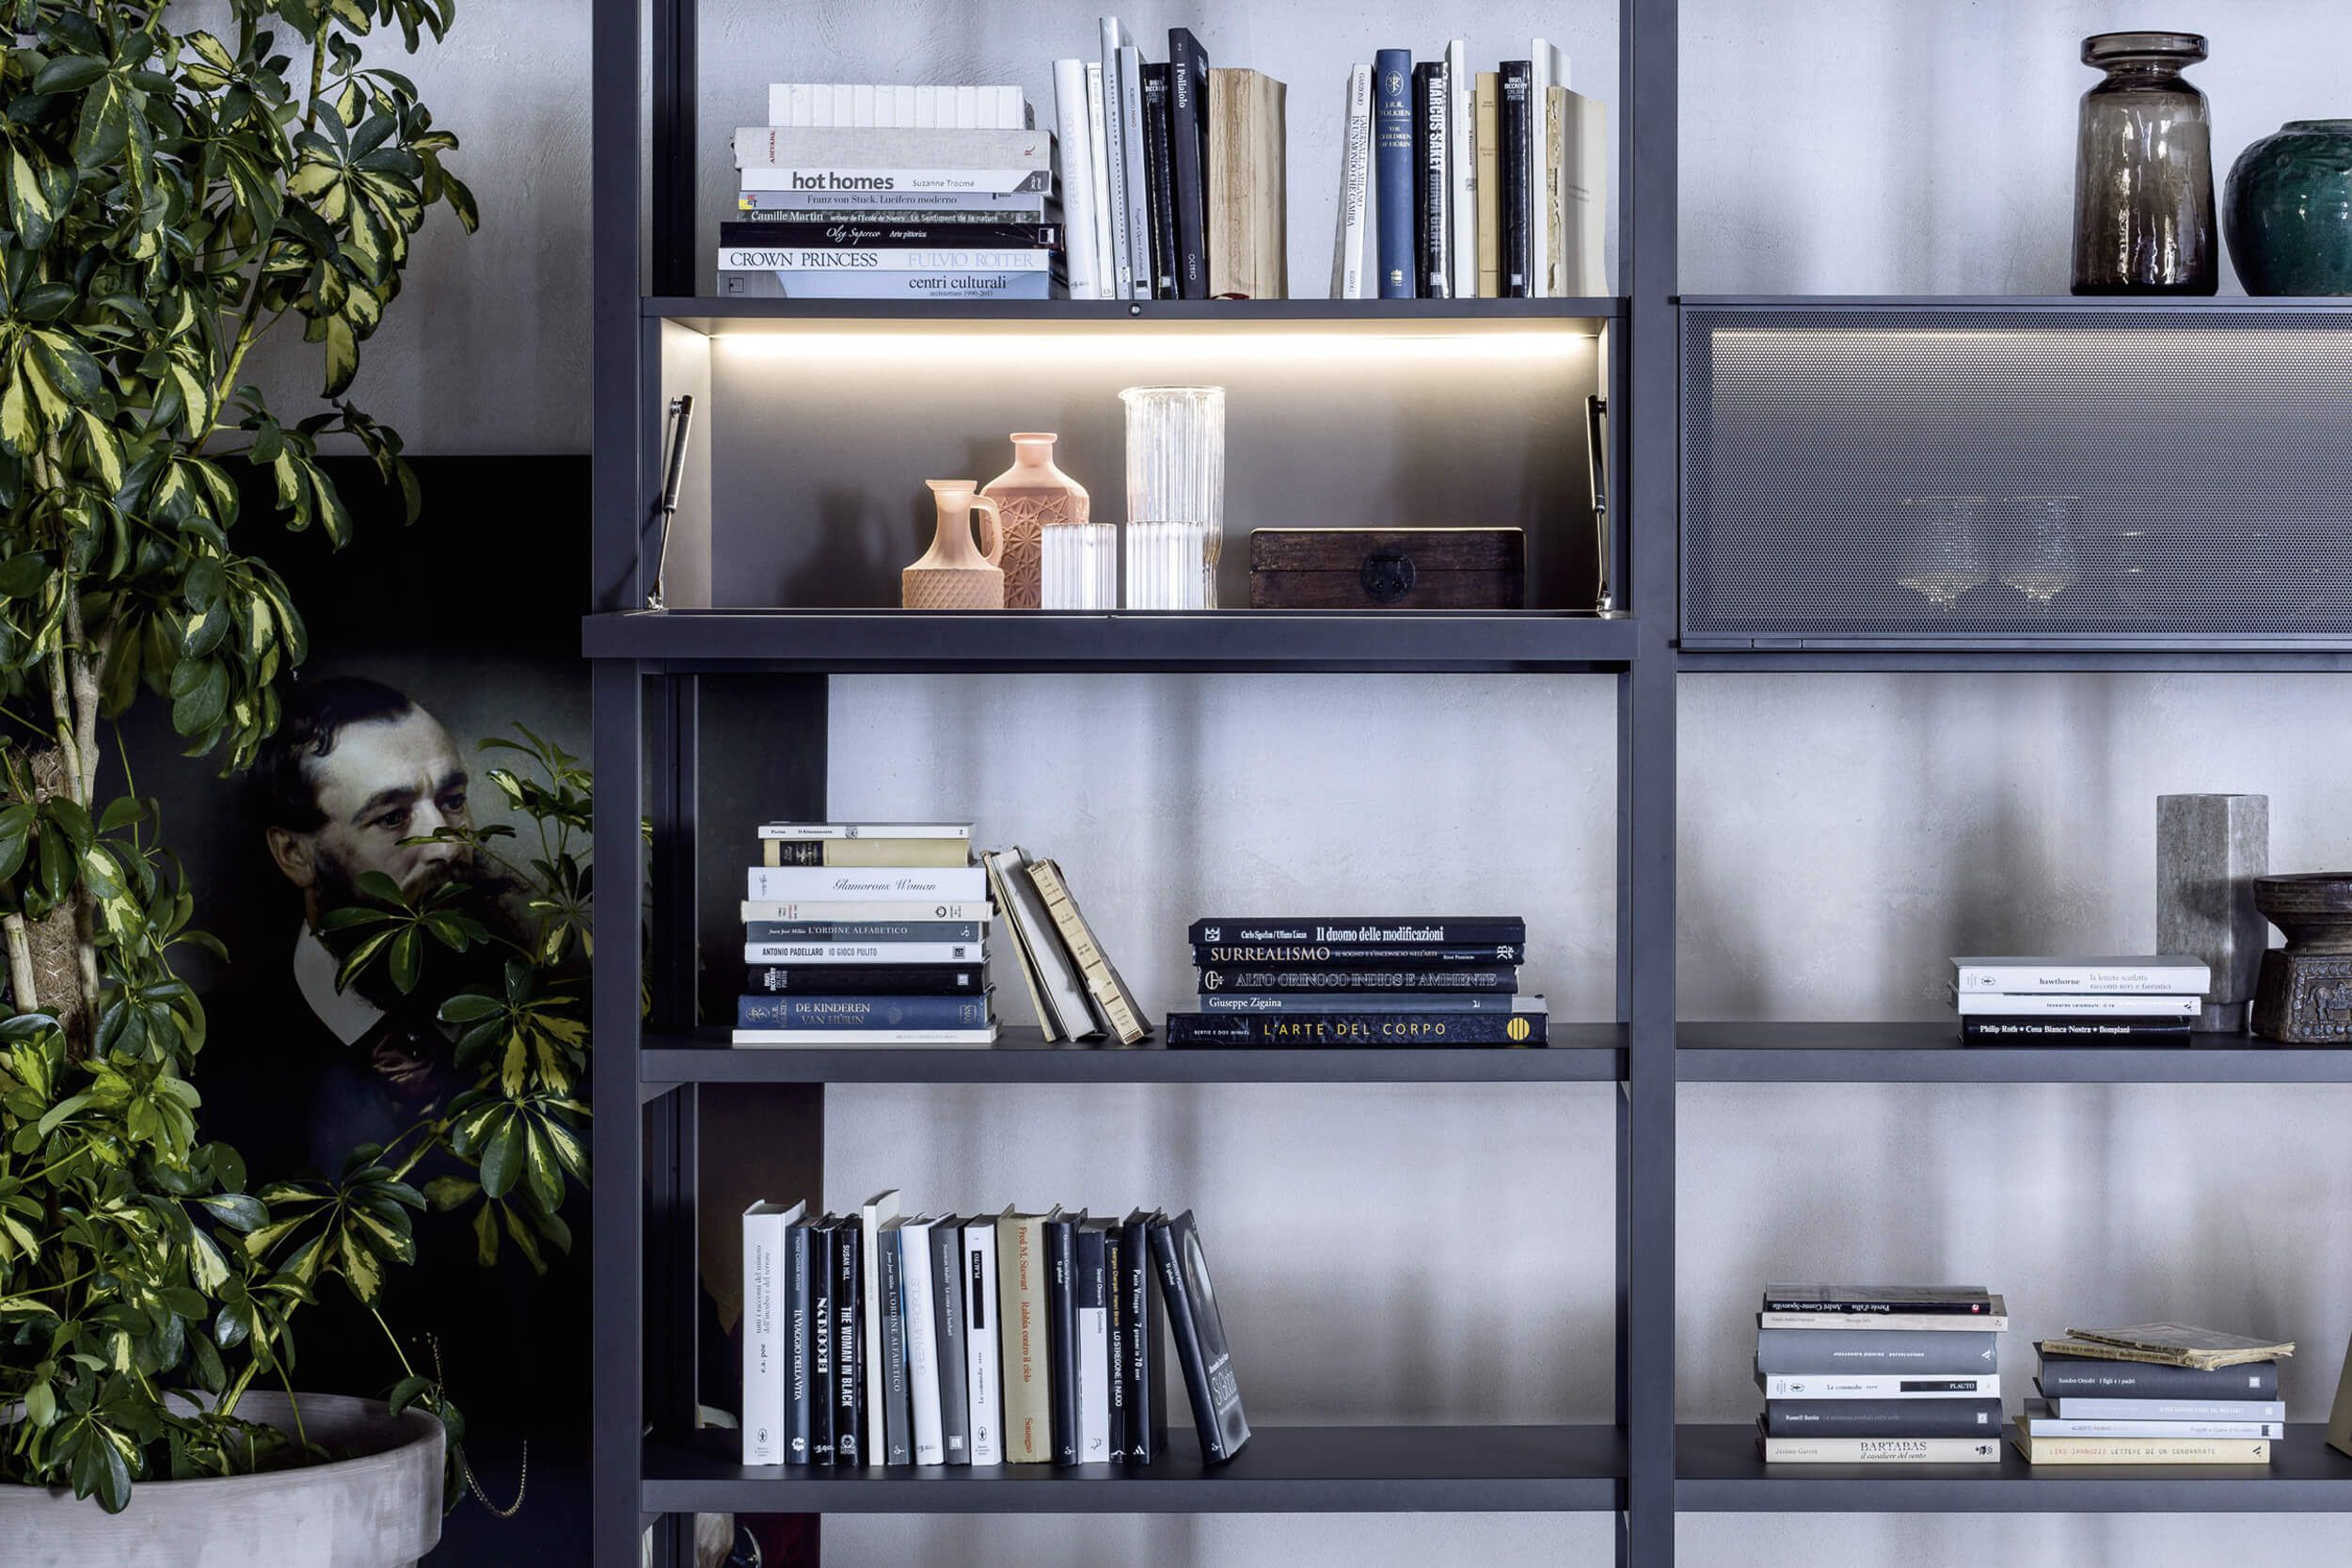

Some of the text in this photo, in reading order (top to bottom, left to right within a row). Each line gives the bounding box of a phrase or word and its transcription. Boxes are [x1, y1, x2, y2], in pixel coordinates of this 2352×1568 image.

[1177, 69, 1187, 108] Pollaiolo
[1429, 78, 1442, 170] MARCUS SAKEY
[1356, 115, 1368, 207] CARDINALE MILANO
[1347, 115, 1359, 228] IN UN MONDO CHE CAMBIA
[792, 171, 896, 190] hot homes
[912, 180, 945, 189] Suzanne
[807, 195, 834, 205] Franz
[834, 197, 850, 205] von
[880, 195, 916, 205] Lucifero
[917, 195, 958, 205] moderno
[751, 211, 824, 222] Camille Martin
[826, 224, 847, 243] Oleg
[730, 252, 879, 267] CROWN PRINCESS
[908, 252, 1034, 267] FULVIO ROITER
[909, 276, 1008, 290] centri culturali
[833, 878, 937, 892] Glamorous Woman
[807, 926, 850, 934] L'ORDINE
[851, 926, 909, 935] ALFABETICO
[1315, 926, 1445, 942] Il duomo delle modificazioni
[761, 947, 878, 957] ANTONIO PADELLARO IO GIOCO PULITO
[1210, 946, 1331, 961] SURREALISMO
[1408, 948, 1438, 957] NELL'ARTE
[1234, 973, 1498, 988] ALTO ORINOCO INDIOS E AMBIENTE
[795, 1003, 871, 1013] DE KINDEREN
[1208, 997, 1282, 1010] Giuseppe Zigaina
[801, 1015, 826, 1024] VAN
[1263, 1023, 1447, 1036] L'ARTE DEL CORPO
[1979, 1025, 2000, 1035] Philip
[2001, 1025, 2018, 1034] Roth
[2099, 1025, 2131, 1035] Bompiani
[1019, 1227, 1028, 1244] Fred
[1019, 1246, 1028, 1259] M.
[842, 1244, 850, 1280] SUSAN HILL
[1020, 1259, 1029, 1291] Stewart
[1133, 1269, 1141, 1286] Paolo
[1132, 1288, 1141, 1314] Villaggio
[1021, 1301, 1031, 1329] Rabbia
[817, 1297, 828, 1373] BROOKLYN
[889, 1291, 900, 1392] L'ORDINE ALFABETICO
[1022, 1329, 1030, 1355] contro
[1113, 1331, 1121, 1341] LO
[759, 1343, 769, 1359] poe
[840, 1307, 853, 1407] THE WOMAN IN BLACK
[794, 1320, 803, 1401] VIAGGIO DELLA VITA
[1113, 1341, 1122, 1379] STREGONE
[1135, 1356, 1143, 1367] 70
[1024, 1364, 1032, 1383] cielo
[977, 1396, 984, 1404] Le
[1023, 1417, 1034, 1454] Sonzogno
[1860, 1441, 1928, 1451] BARTABAS
